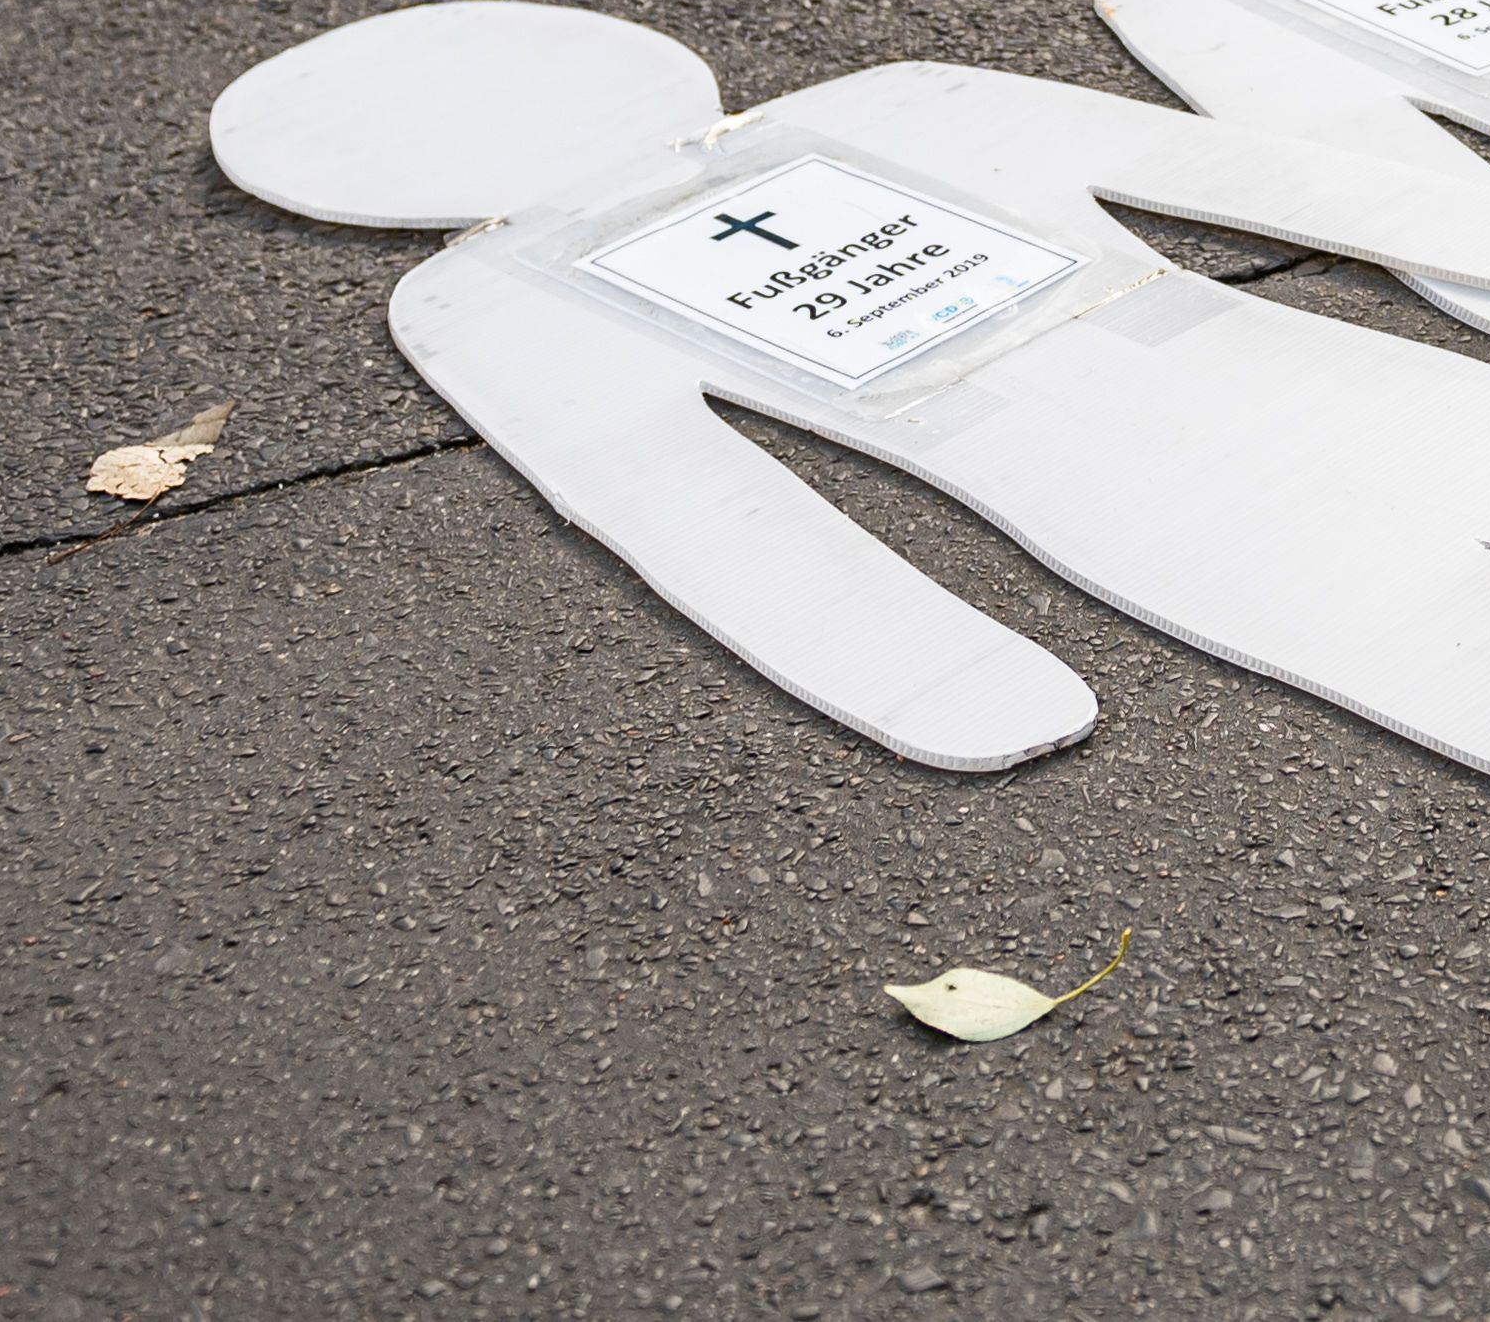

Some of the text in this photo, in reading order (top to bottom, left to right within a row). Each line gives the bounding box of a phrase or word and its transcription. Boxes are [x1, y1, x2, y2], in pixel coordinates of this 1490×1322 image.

[1430, 7, 1478, 27] 28
[726, 214, 918, 309] Fußgänger
[792, 243, 951, 321] 29 Jahre
[826, 253, 989, 339] 6. September 2019
